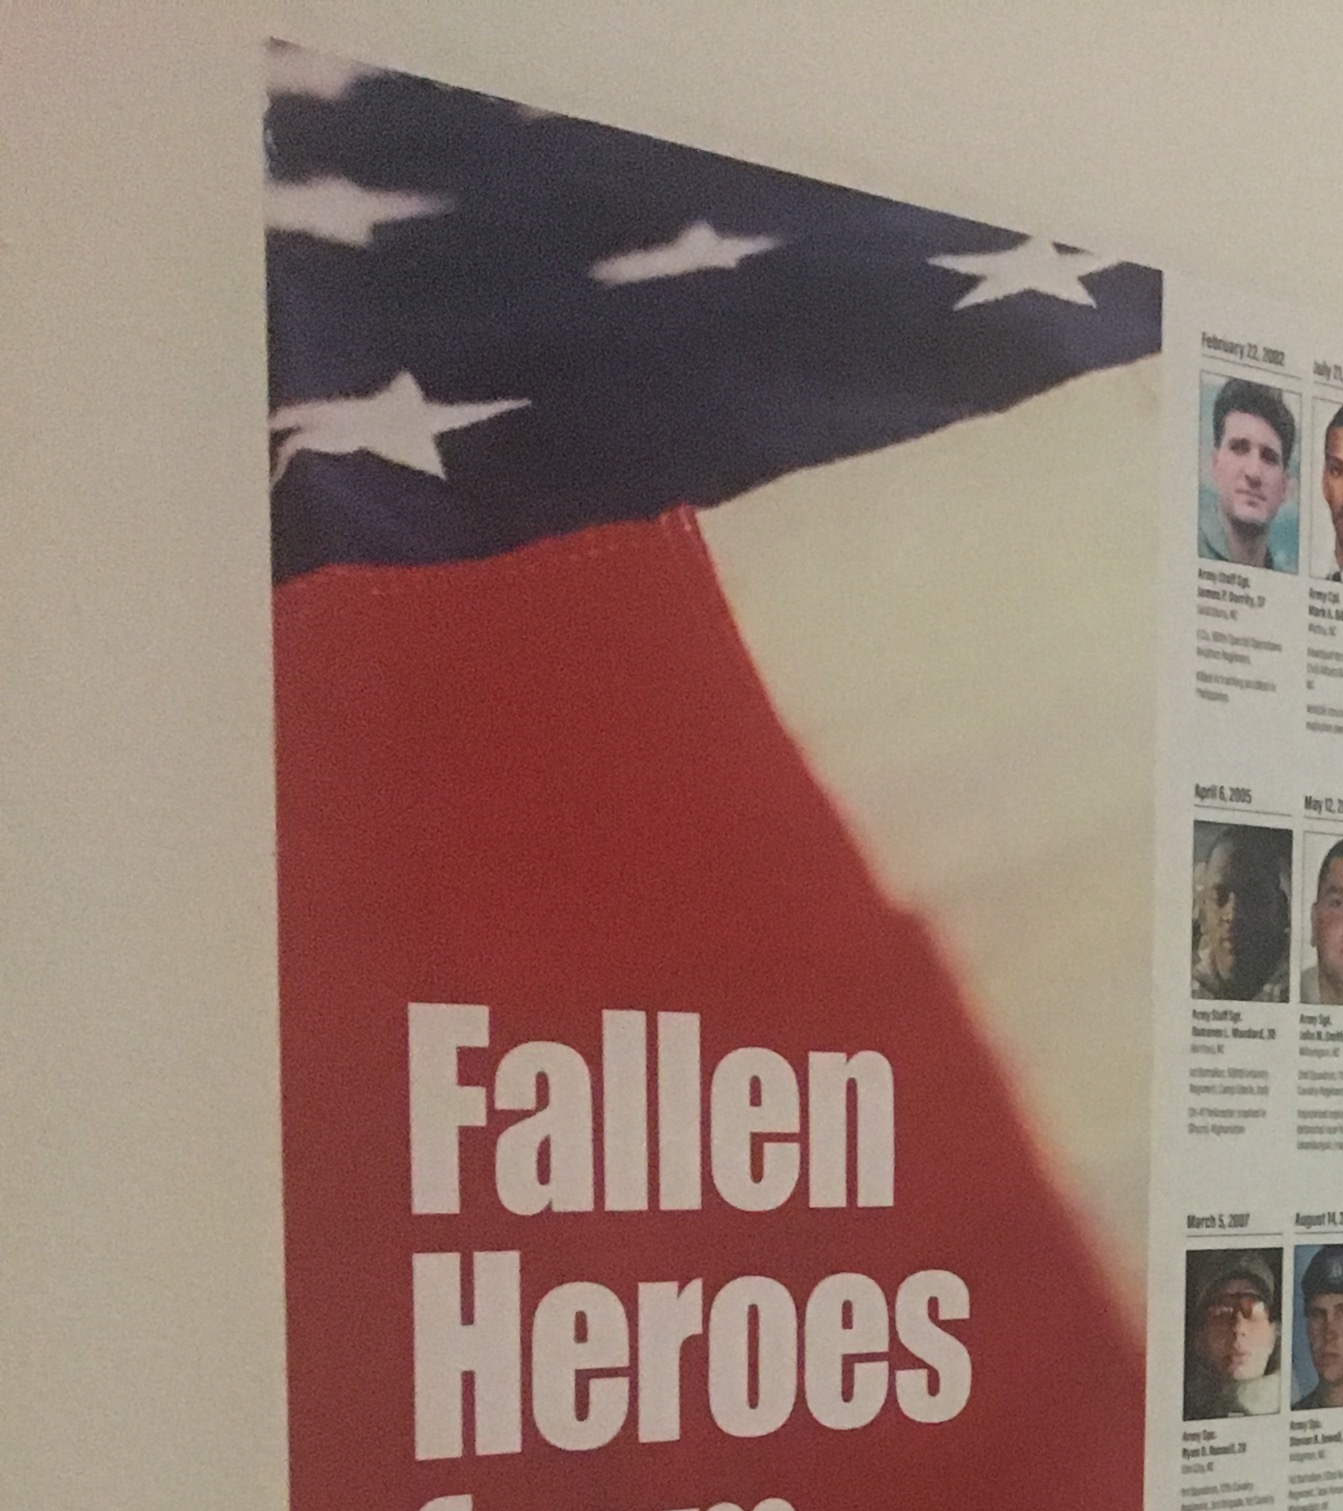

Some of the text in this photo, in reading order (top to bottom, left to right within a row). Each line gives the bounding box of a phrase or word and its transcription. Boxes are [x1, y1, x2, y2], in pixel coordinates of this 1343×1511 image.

[1202, 331, 1245, 360] February
[1263, 346, 1285, 367] 2002
[1313, 359, 1331, 382] July
[1194, 783, 1217, 802] April
[1229, 787, 1252, 804] 2005
[1304, 796, 1322, 815] May
[408, 1002, 895, 1216] Fallen
[1187, 1213, 1250, 1230] March 5, 2007
[1295, 1212, 1325, 1230] August
[412, 1249, 973, 1461] Heroes
